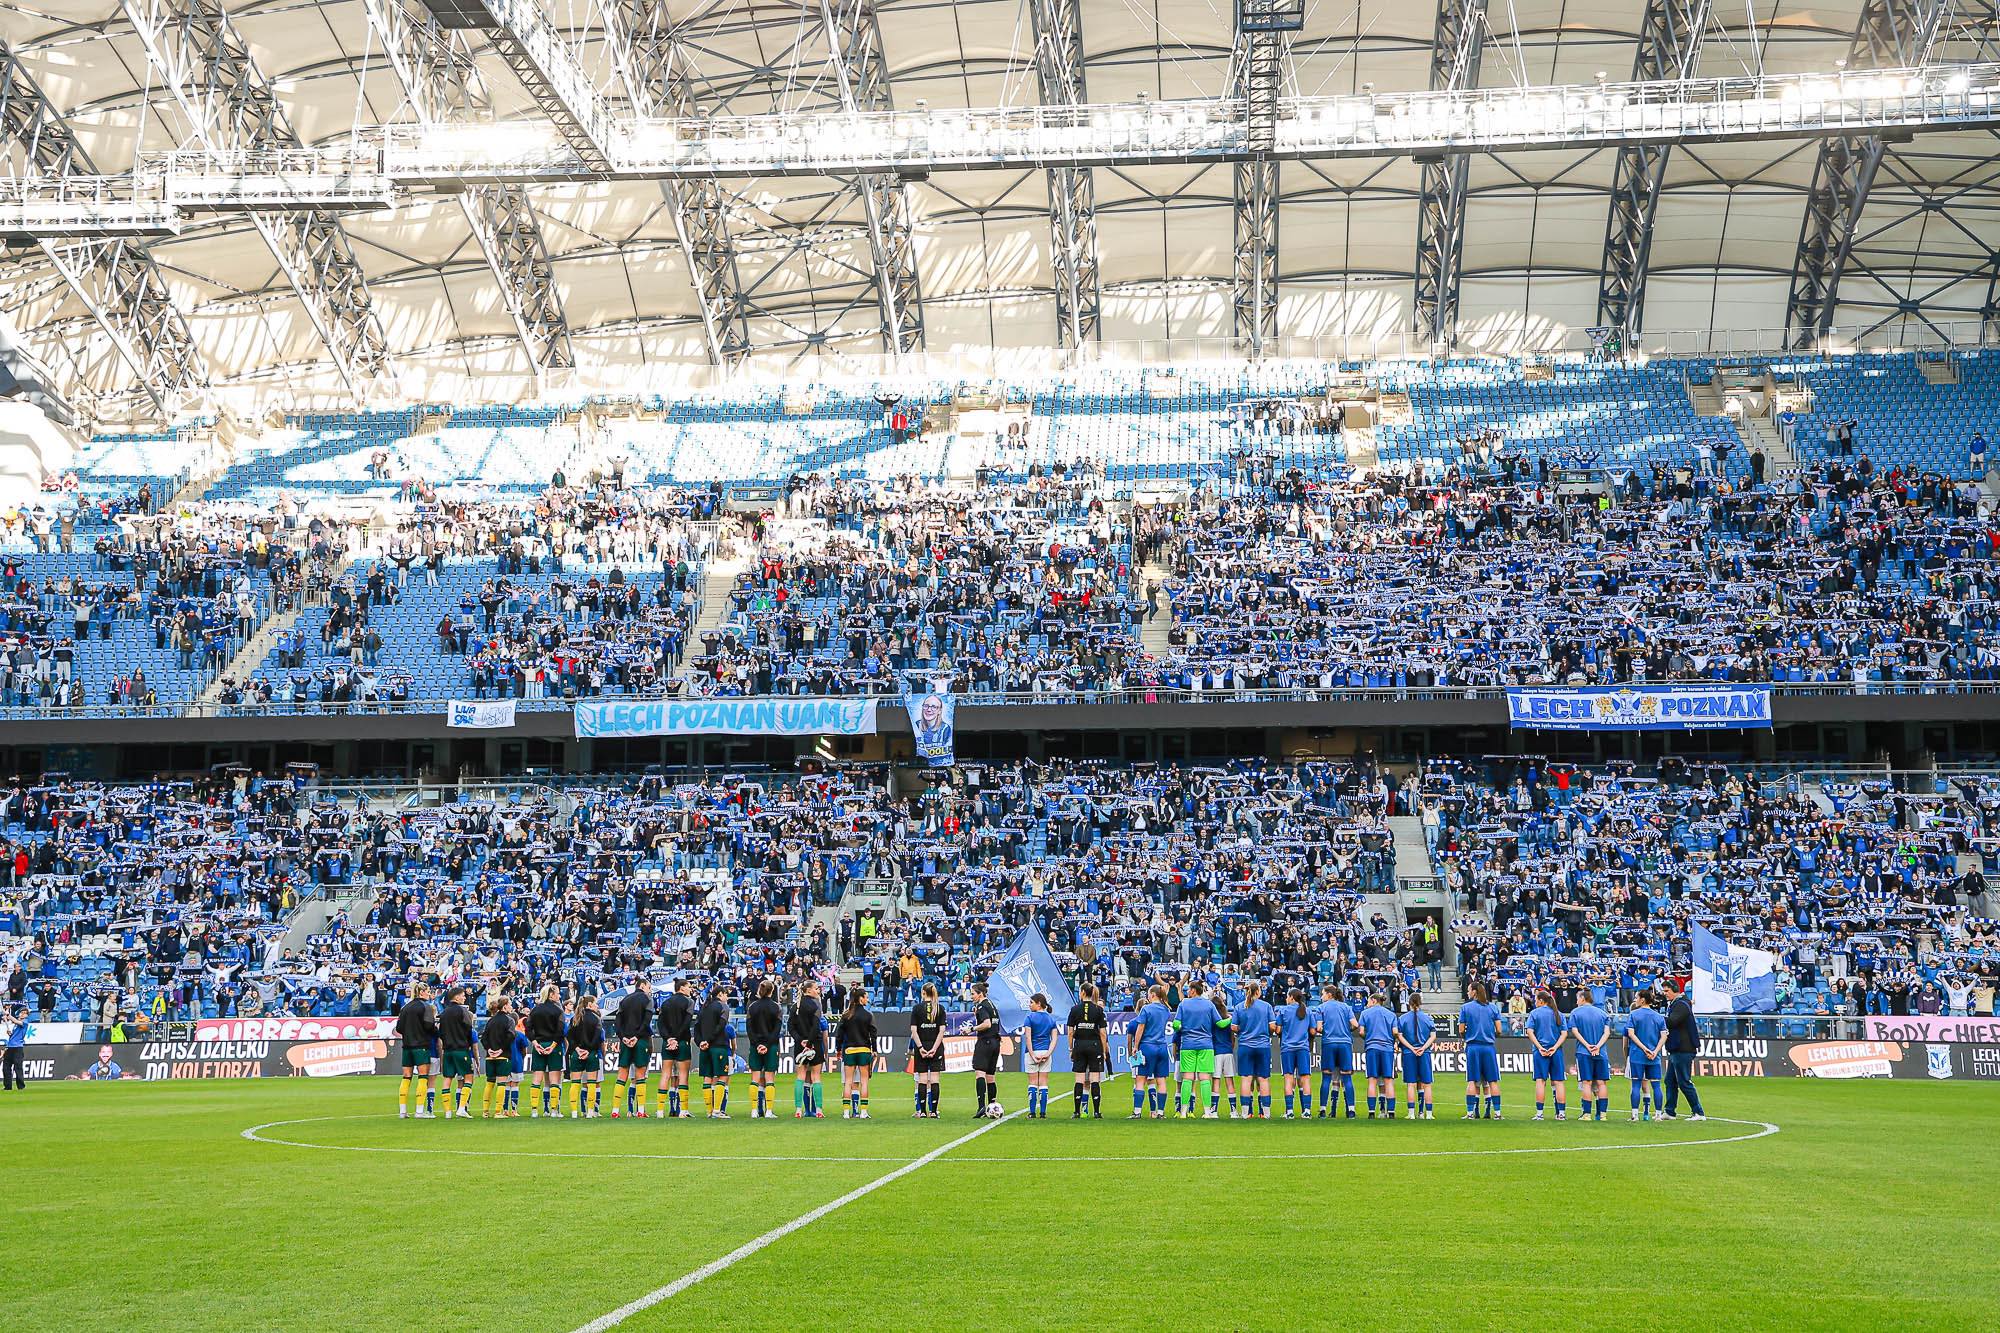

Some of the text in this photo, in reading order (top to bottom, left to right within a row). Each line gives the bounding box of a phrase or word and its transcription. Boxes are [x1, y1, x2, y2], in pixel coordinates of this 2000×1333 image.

[1510, 695, 1594, 719] LECH
[1661, 688, 1767, 718] POZNAŃ
[599, 700, 842, 732] LECH POZNAŃ UAM
[1600, 716, 1658, 725] FANATICS
[1873, 1022, 1931, 1041] BODY
[1972, 1048, 2000, 1062] LECH
